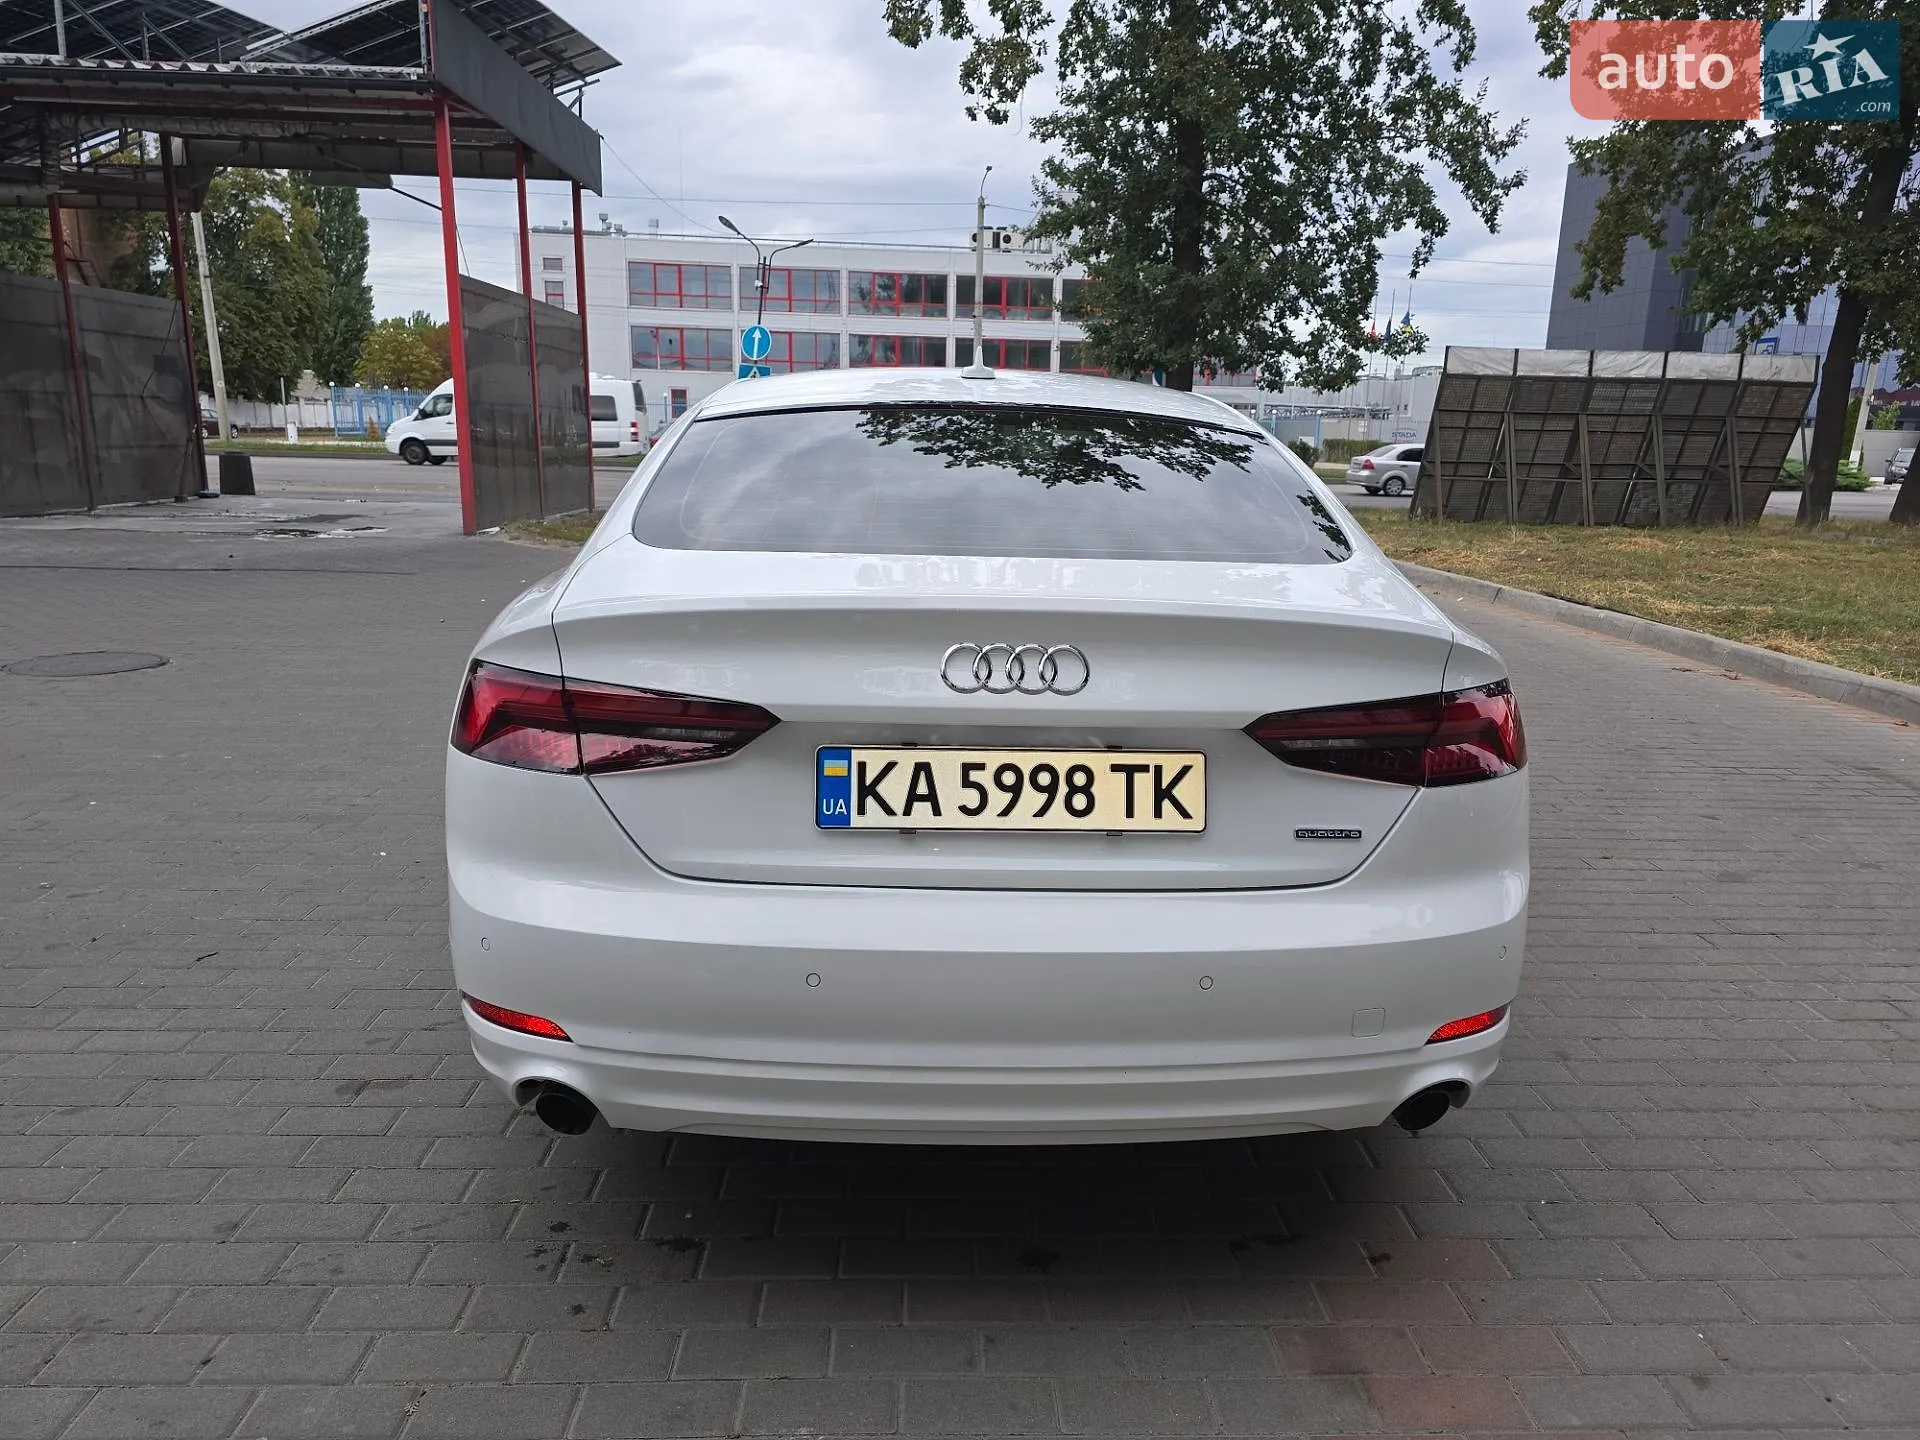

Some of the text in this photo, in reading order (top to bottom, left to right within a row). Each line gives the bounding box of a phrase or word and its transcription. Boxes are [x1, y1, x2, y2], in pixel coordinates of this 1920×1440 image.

[856, 760, 1194, 820] KA 5998 TK
[822, 798, 848, 815] UA
[1298, 830, 1360, 838] quattro
